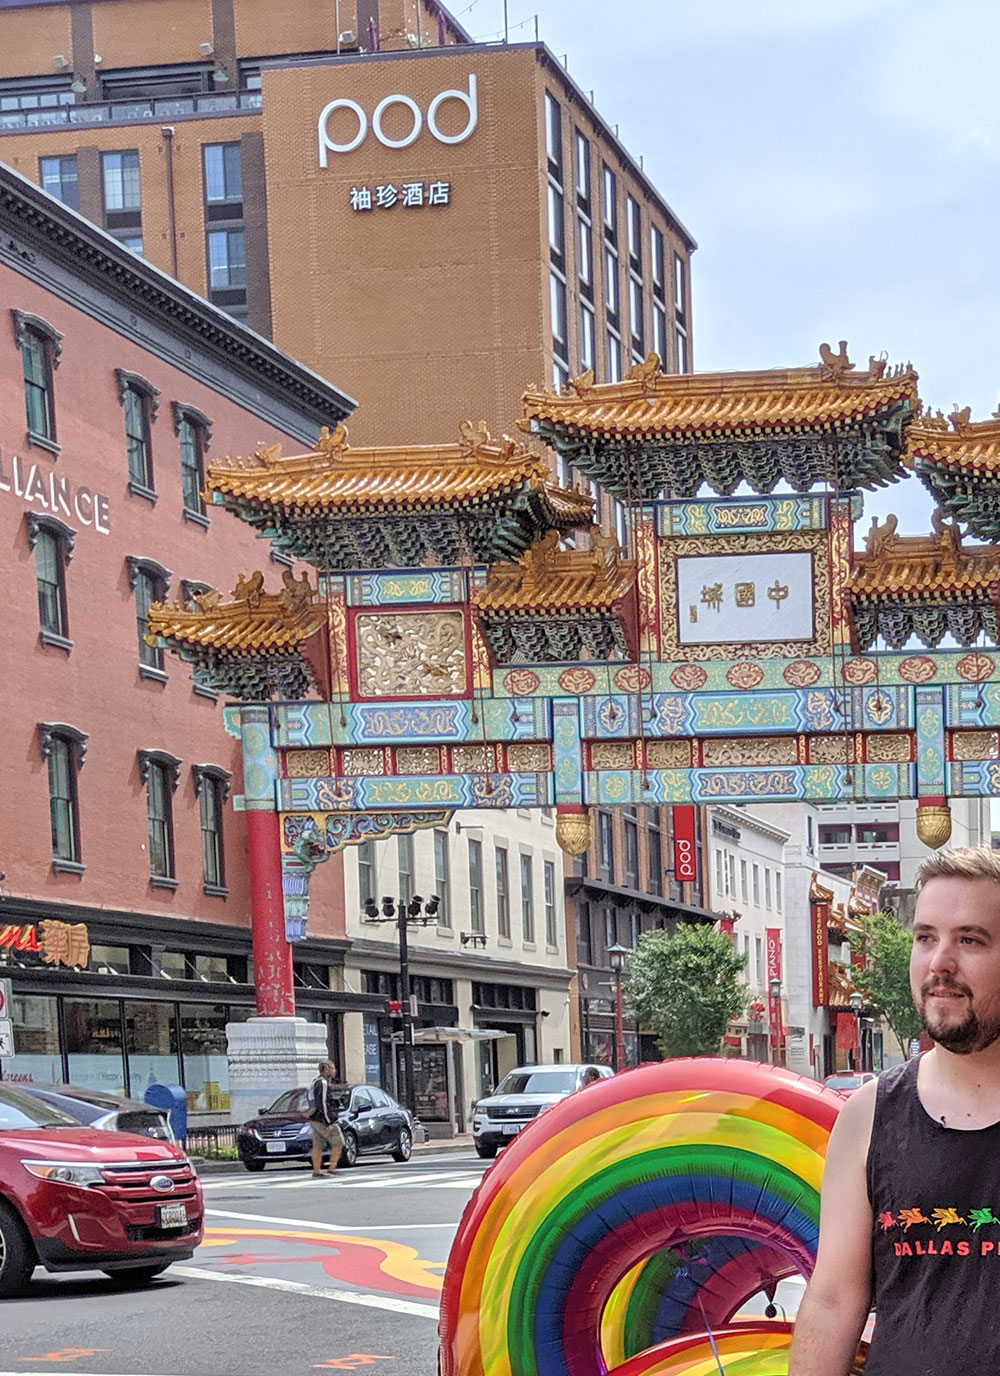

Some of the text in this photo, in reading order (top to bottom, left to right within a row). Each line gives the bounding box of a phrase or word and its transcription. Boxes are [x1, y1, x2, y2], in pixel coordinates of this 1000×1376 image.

[318, 74, 478, 168] pod
[350, 181, 450, 211] 袖珍酒店
[676, 840, 694, 876] pod
[894, 1240, 970, 1256] DALLAS
